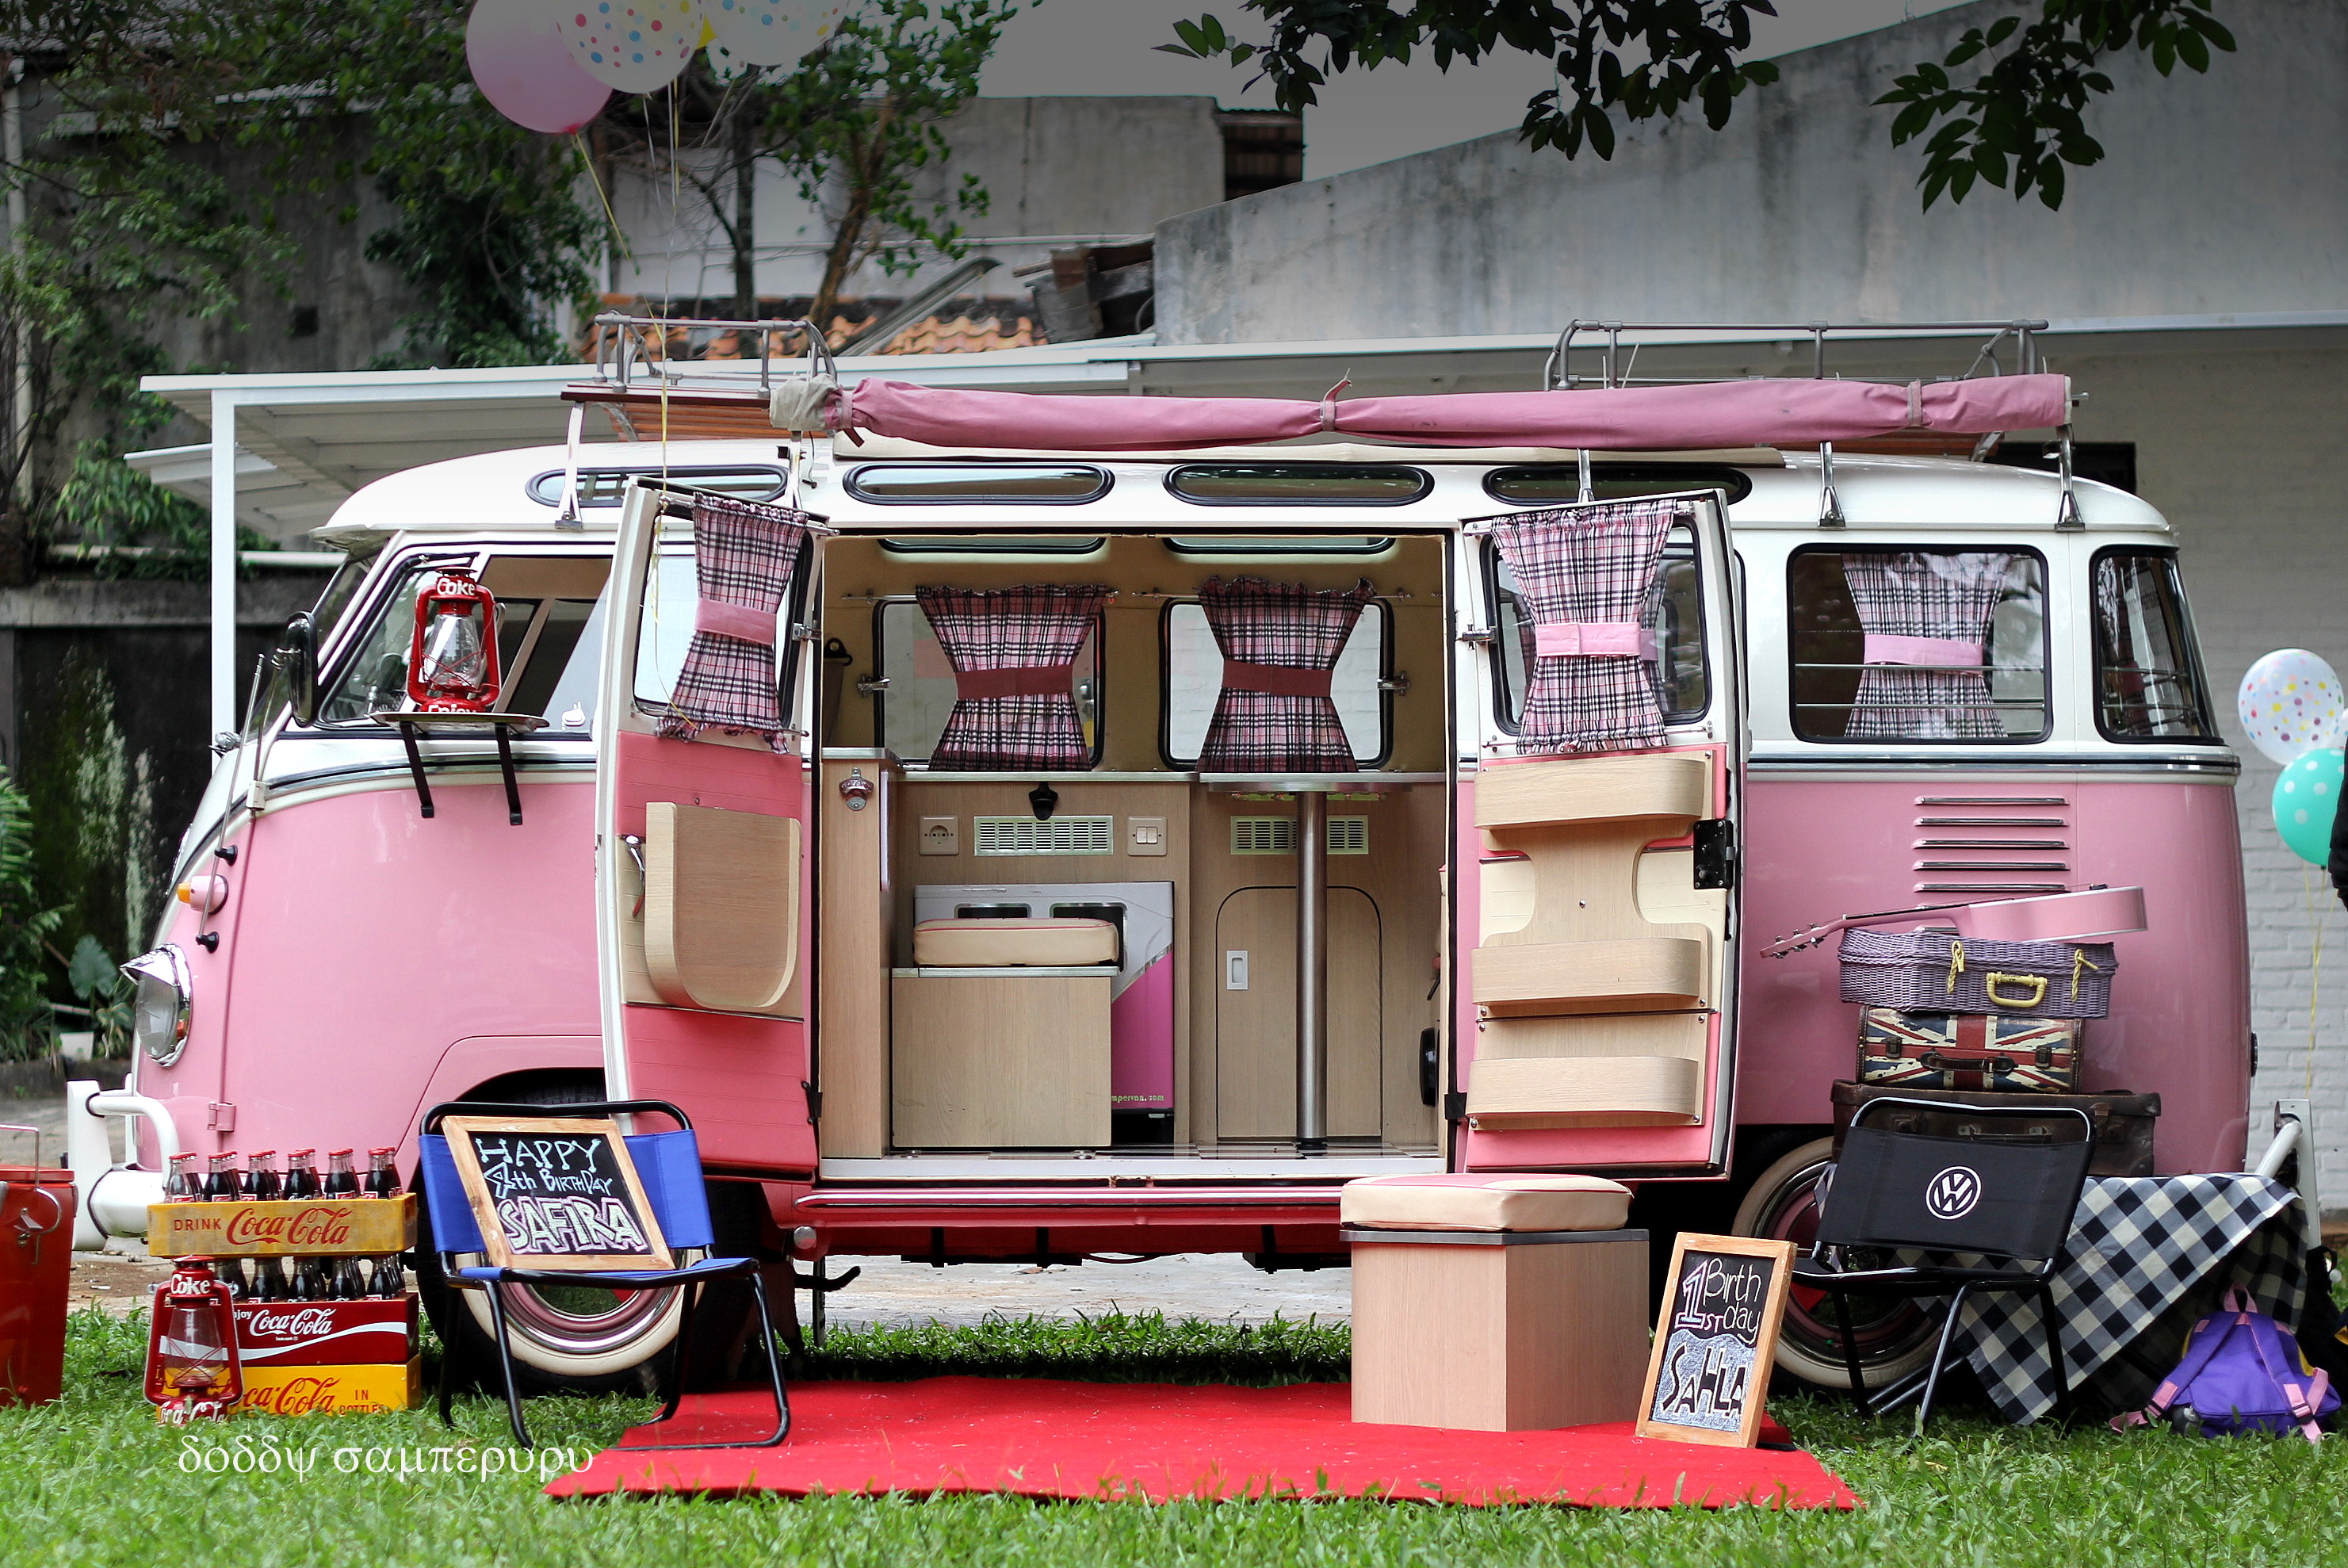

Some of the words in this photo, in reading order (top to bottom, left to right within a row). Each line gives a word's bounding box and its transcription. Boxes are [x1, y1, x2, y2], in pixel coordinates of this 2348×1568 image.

[437, 577, 476, 596] Coke
[476, 1138, 602, 1173] HAPPY
[174, 1218, 222, 1231] DRINK
[226, 1207, 353, 1245] Coca-Cola
[497, 1195, 648, 1254] SAFIRA
[170, 1273, 211, 1295] Coke
[1703, 1257, 1761, 1306] Birth
[234, 1309, 253, 1320] njoy
[249, 1308, 337, 1337] Coca-Cola
[1723, 1301, 1761, 1345] day
[240, 1377, 342, 1415] ca-Cola
[355, 1390, 369, 1400] IN
[1660, 1341, 1748, 1419] SAHLA
